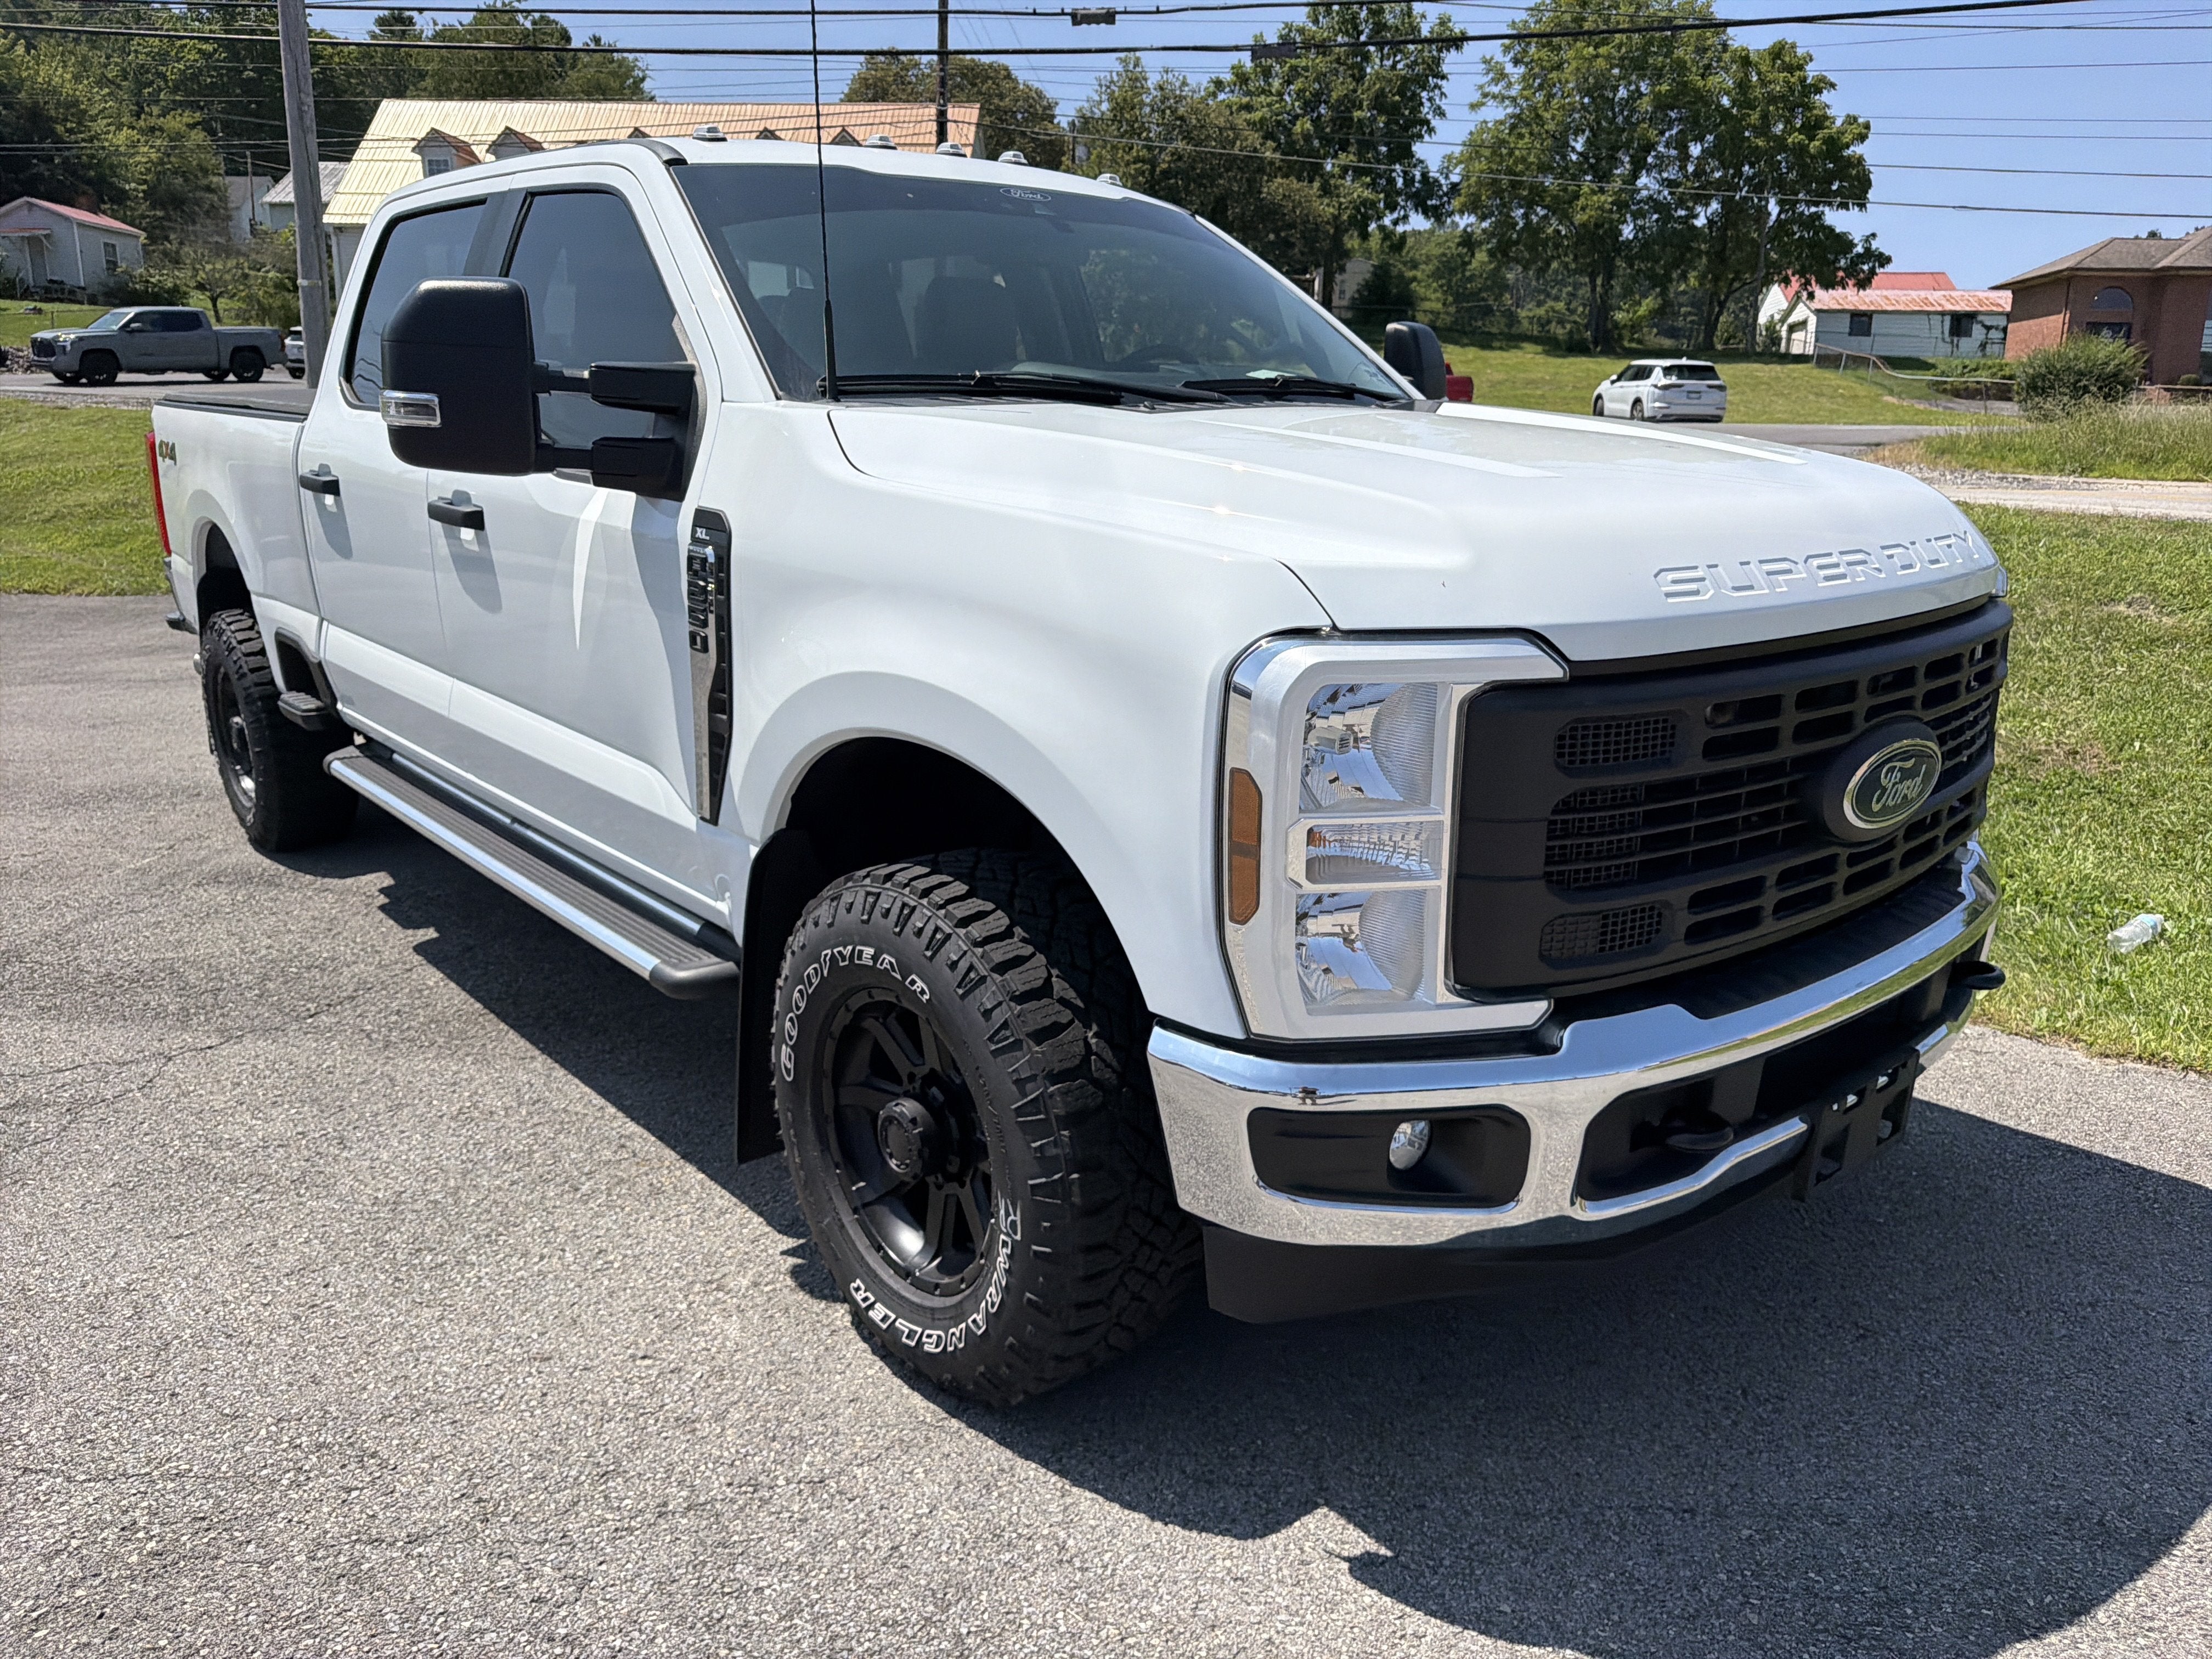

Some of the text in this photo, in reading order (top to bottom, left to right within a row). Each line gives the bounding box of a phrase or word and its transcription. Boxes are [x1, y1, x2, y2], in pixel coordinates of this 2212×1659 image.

[695, 527, 710, 540] XL
[1653, 529, 1979, 602] SUPER DUTY
[1871, 757, 1927, 812] Ford
[781, 945, 930, 1082] GOODYEAR
[850, 1233, 1012, 1353] WRANGLER
